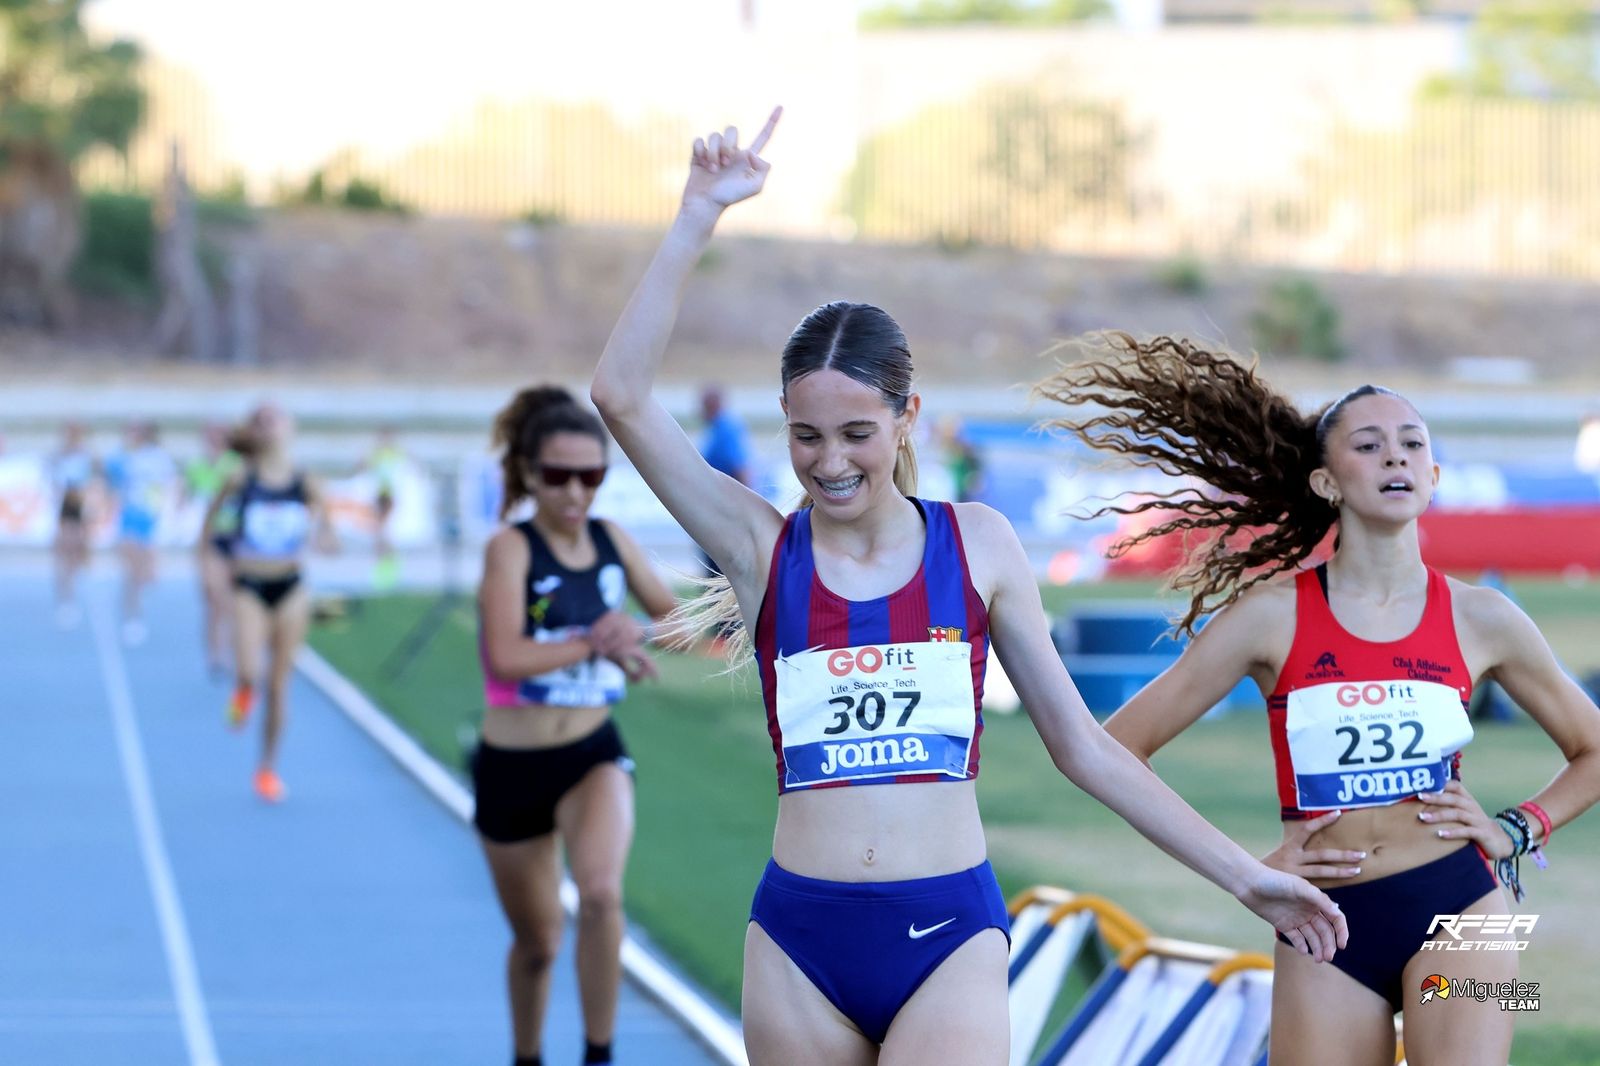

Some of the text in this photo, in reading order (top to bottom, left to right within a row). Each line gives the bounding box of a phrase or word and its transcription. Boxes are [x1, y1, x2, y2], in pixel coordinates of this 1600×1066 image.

[1393, 656, 1413, 669] Club
[824, 691, 921, 735] 307
[1335, 720, 1428, 766] 232
